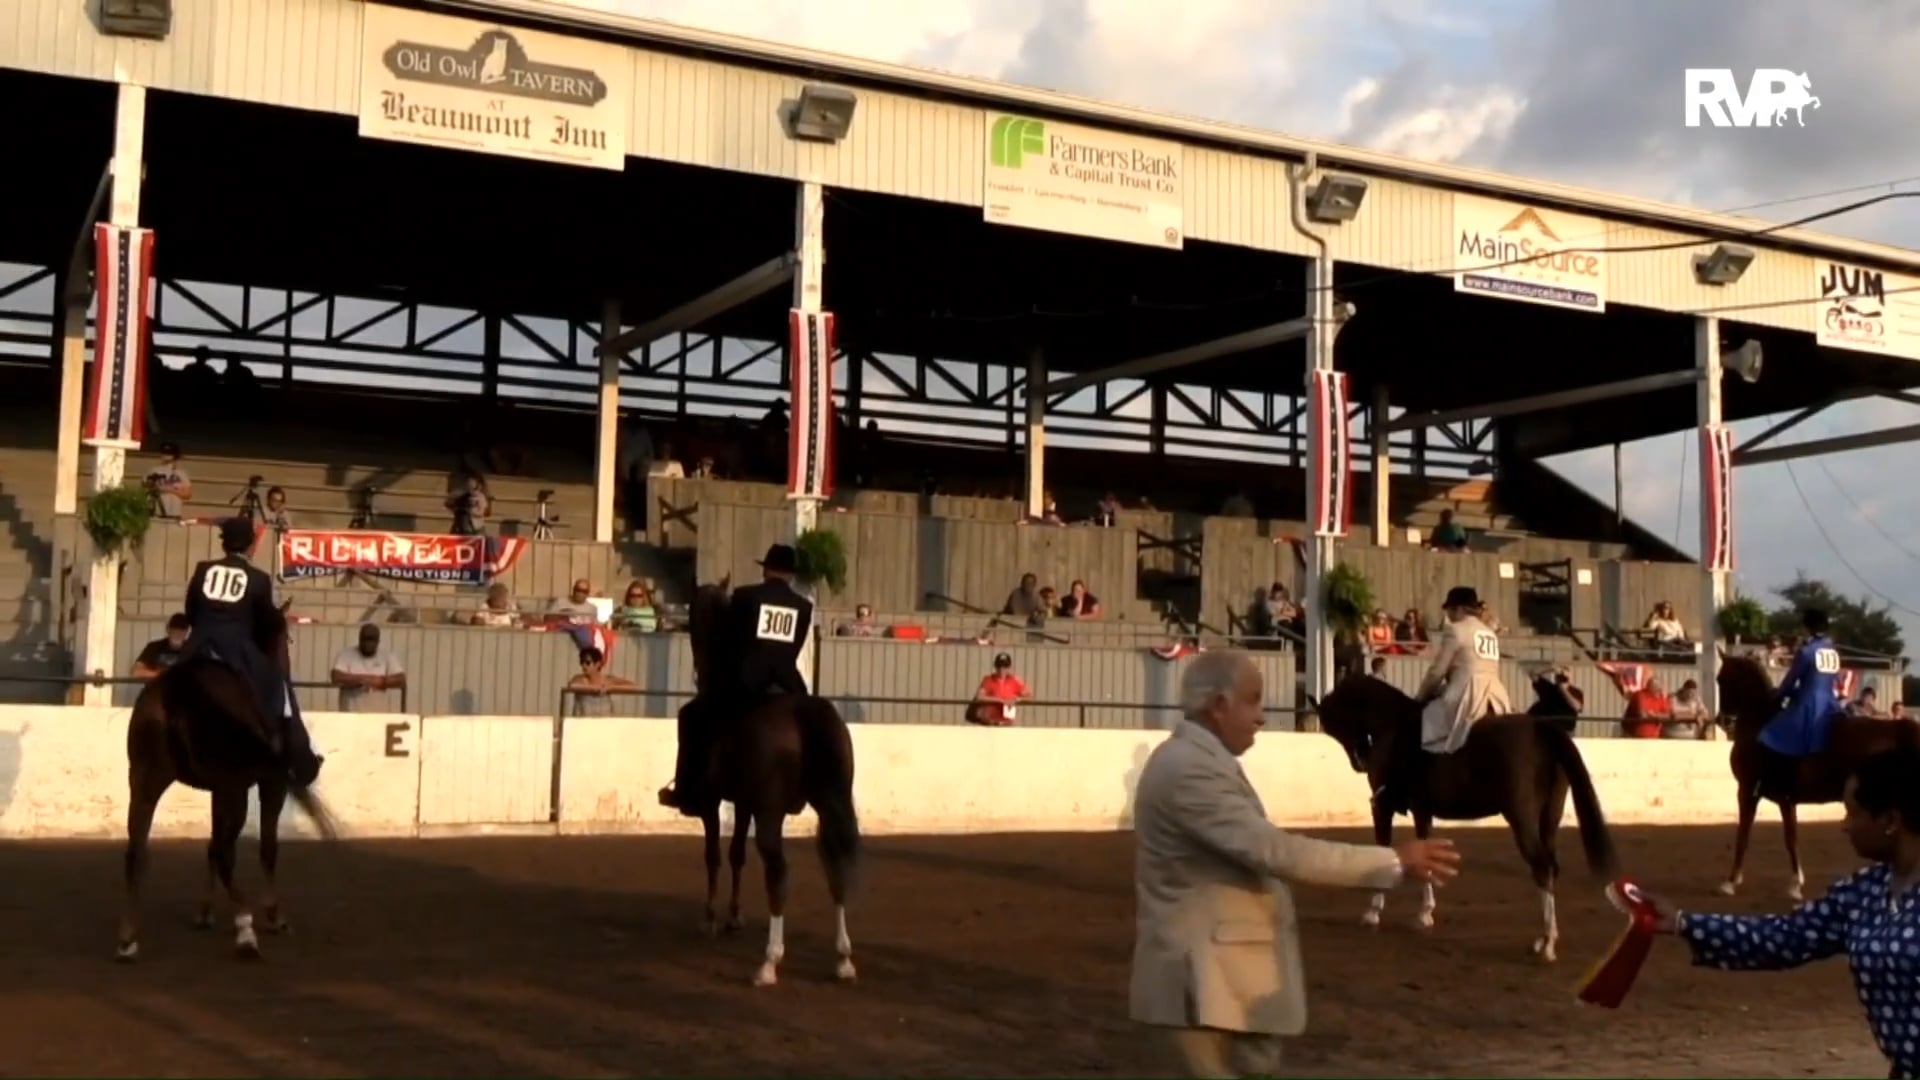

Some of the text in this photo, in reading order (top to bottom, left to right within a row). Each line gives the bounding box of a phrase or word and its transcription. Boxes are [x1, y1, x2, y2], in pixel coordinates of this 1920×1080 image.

[397, 48, 595, 98] Old Owl TAVERN
[381, 89, 532, 140] Beaumont
[550, 115, 607, 151] Inn
[487, 99, 507, 112] AT
[1049, 134, 1178, 179] Farmers Bank
[1049, 162, 1060, 176] &
[1065, 164, 1114, 185] Capital
[1117, 172, 1151, 191] Trust
[1459, 229, 1600, 277] MainSource
[209, 570, 244, 598] 116
[761, 609, 793, 636] 300
[385, 721, 411, 757] E
